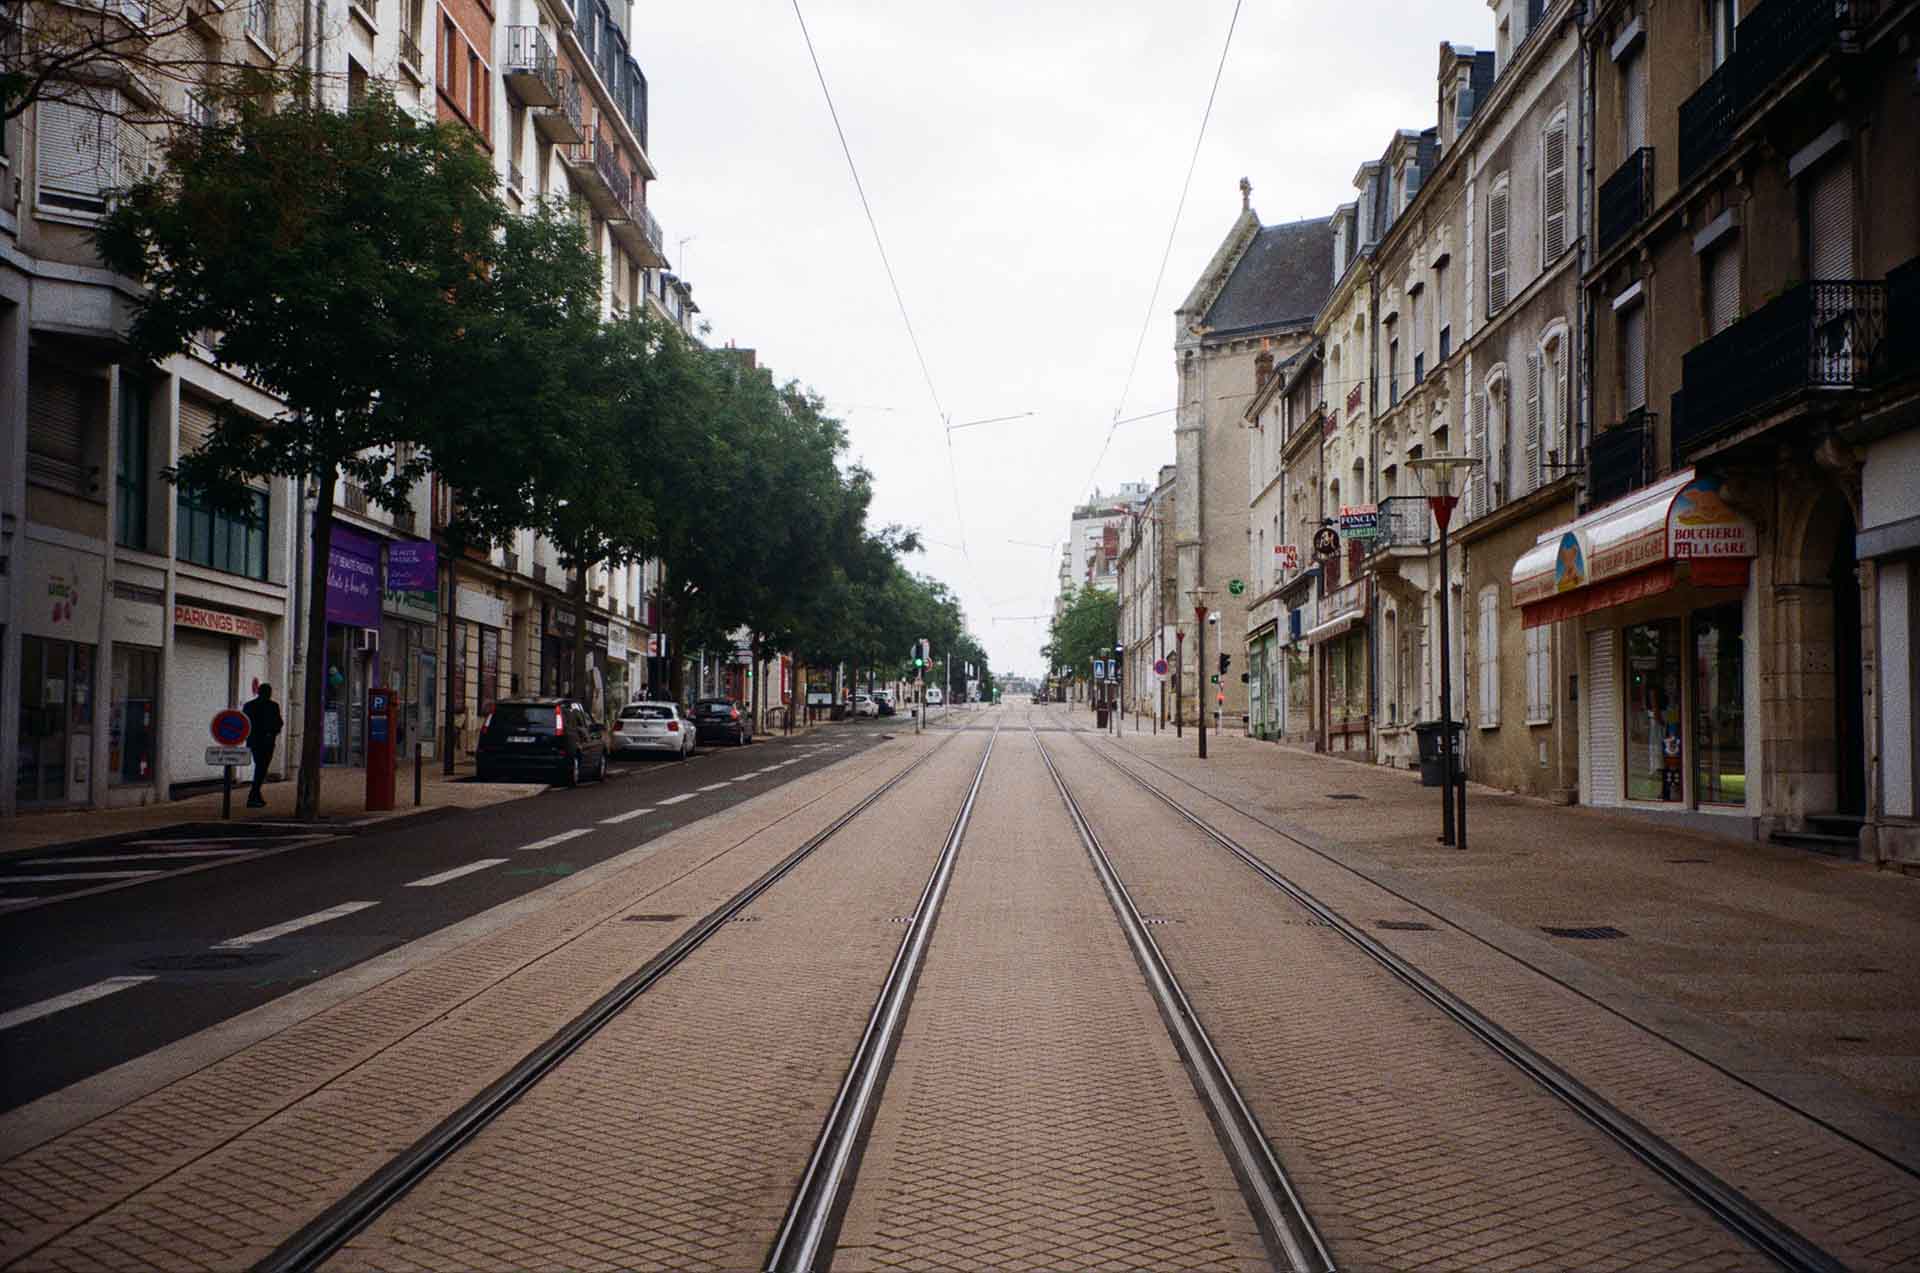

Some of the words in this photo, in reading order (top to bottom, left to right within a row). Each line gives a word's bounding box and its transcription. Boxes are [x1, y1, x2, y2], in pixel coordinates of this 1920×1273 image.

[1341, 513, 1377, 524] FONCIA
[1674, 528, 1745, 540] BOUCHERIE
[1274, 545, 1297, 554] BER
[1674, 542, 1690, 555] DE
[1693, 542, 1709, 554] LA
[1713, 542, 1746, 554] GARE
[1286, 553, 1297, 561] NI
[1282, 561, 1297, 569] NA
[175, 606, 233, 631] PARKINGS
[374, 696, 384, 709] P
